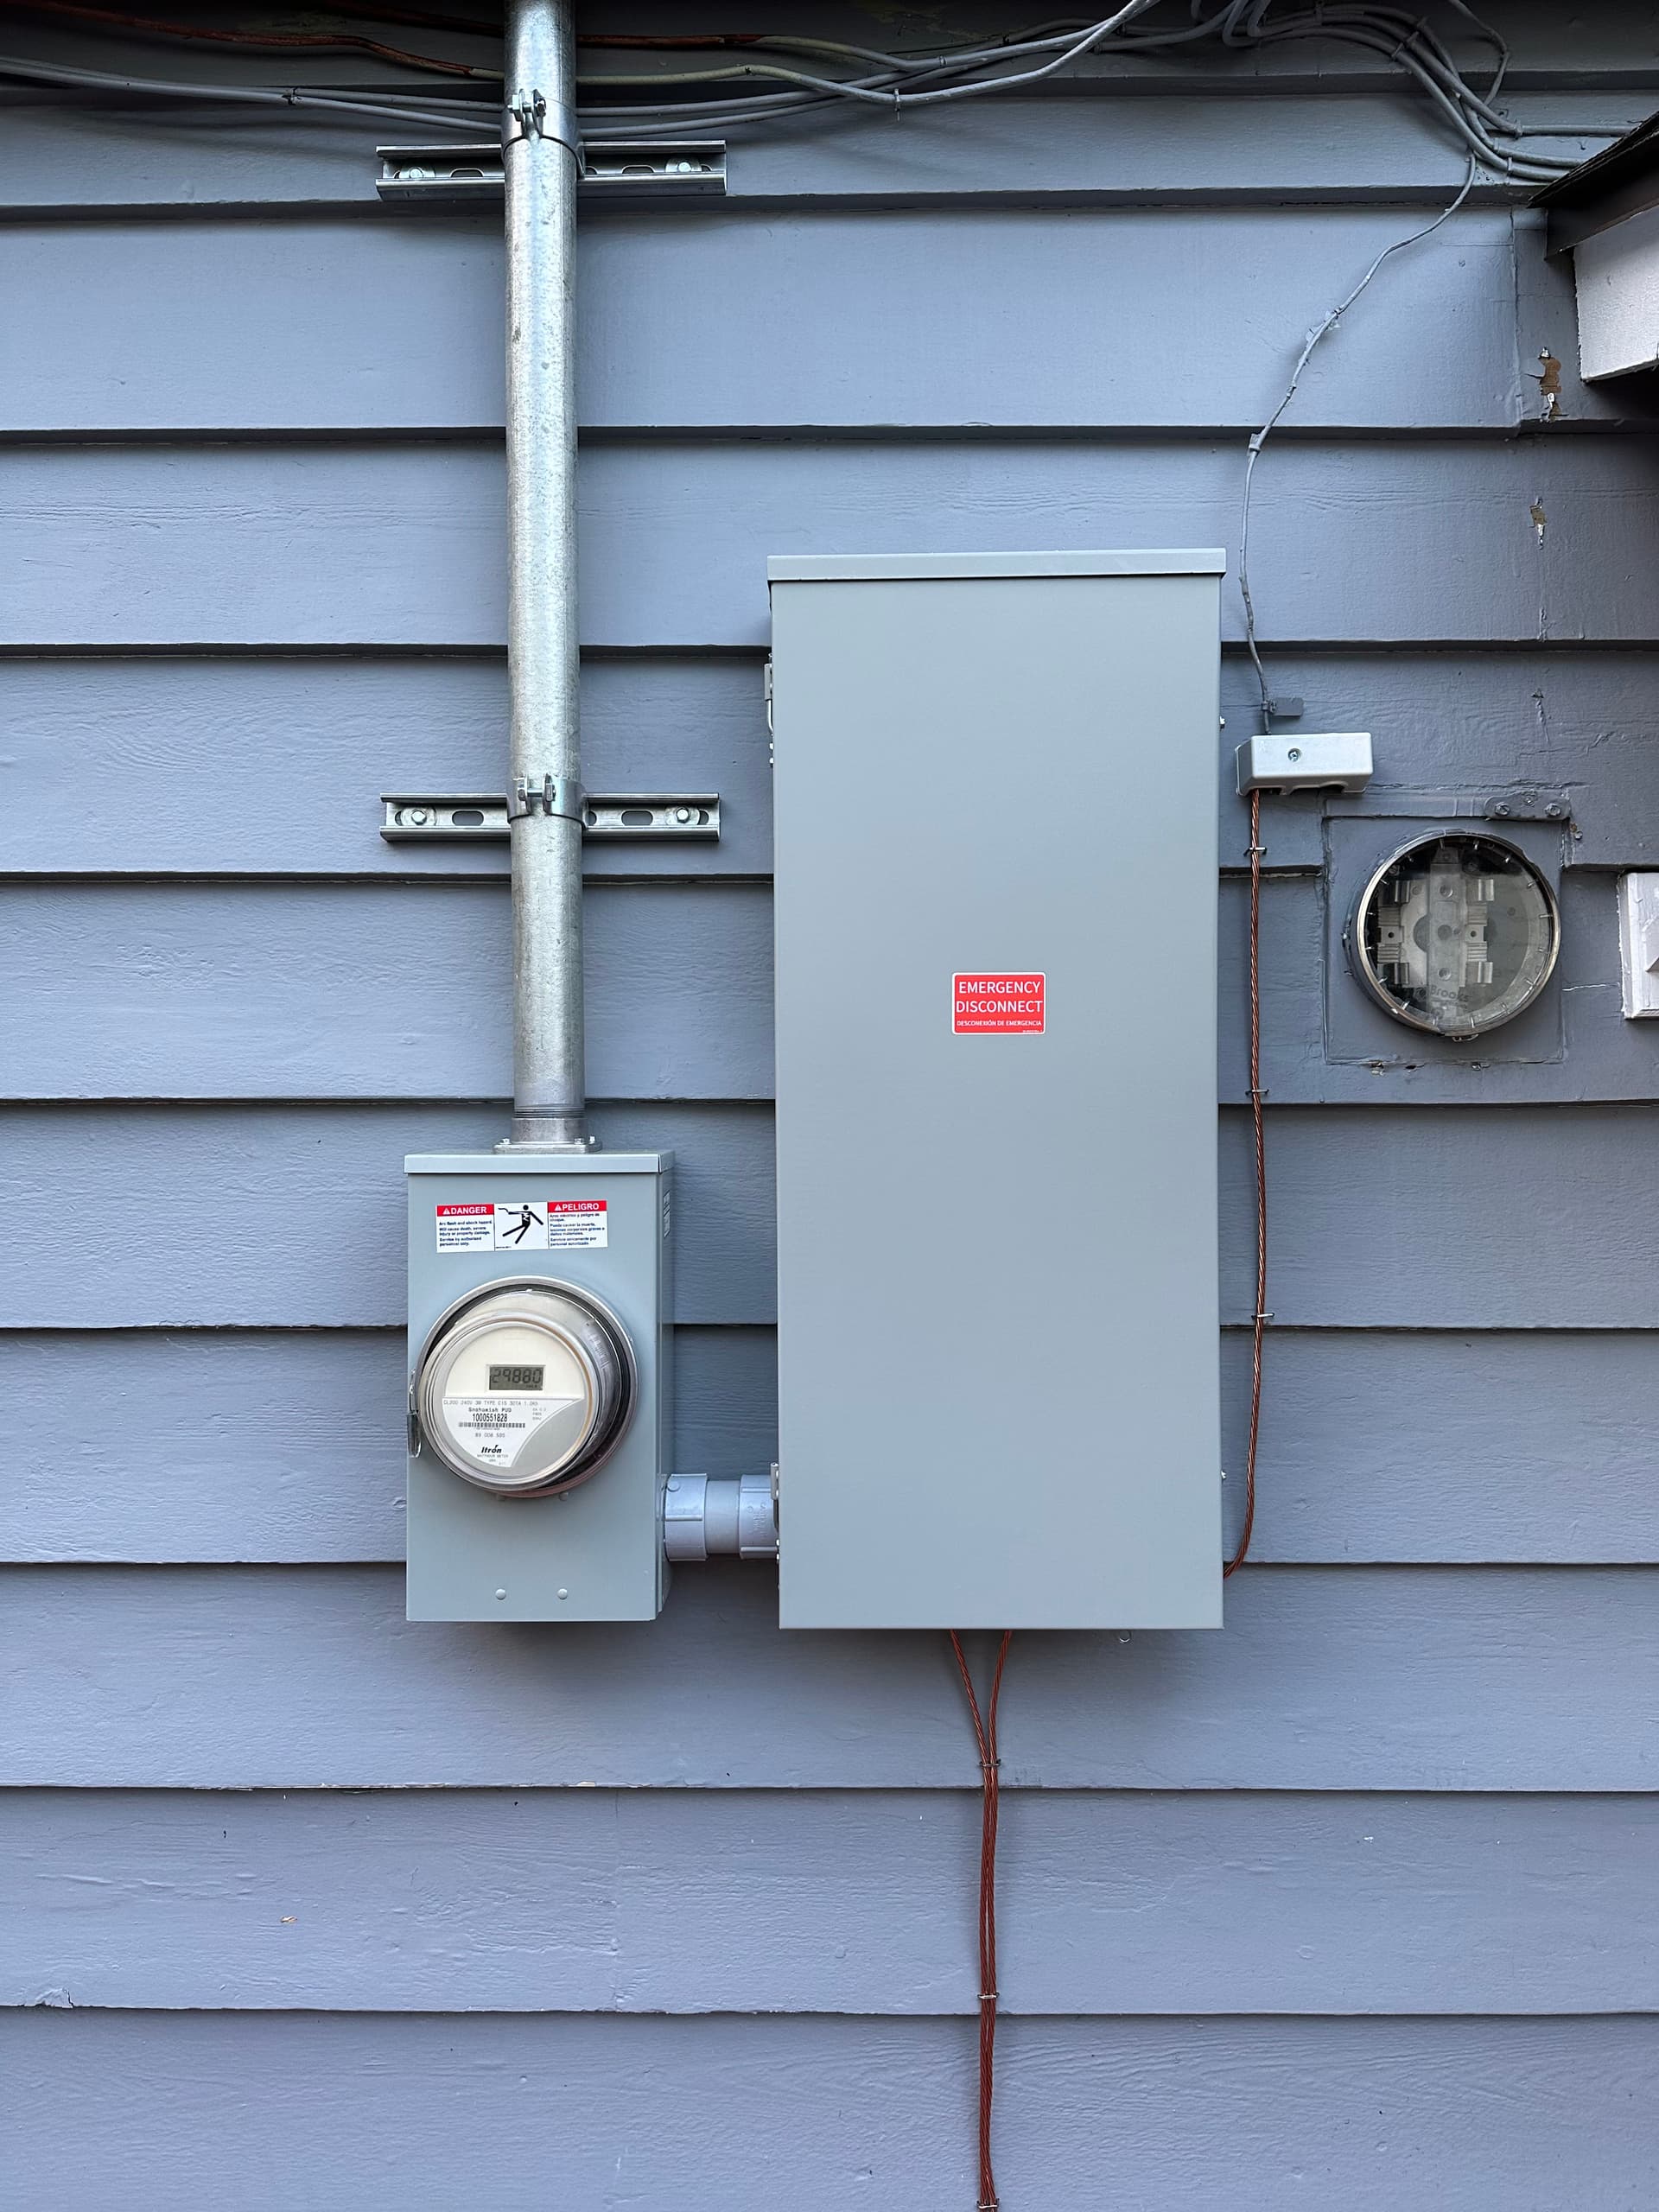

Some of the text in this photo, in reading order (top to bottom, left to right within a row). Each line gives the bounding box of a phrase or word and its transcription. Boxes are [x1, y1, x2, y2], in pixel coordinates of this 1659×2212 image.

[959, 981, 1040, 994] EMERGENCY
[956, 1001, 1043, 1013] DISCONNECT
[450, 1206, 487, 1215] DANGER
[492, 1368, 542, 1383] 29880
[473, 1413, 508, 1422] 1000551828
[480, 1444, 502, 1453] Itron
